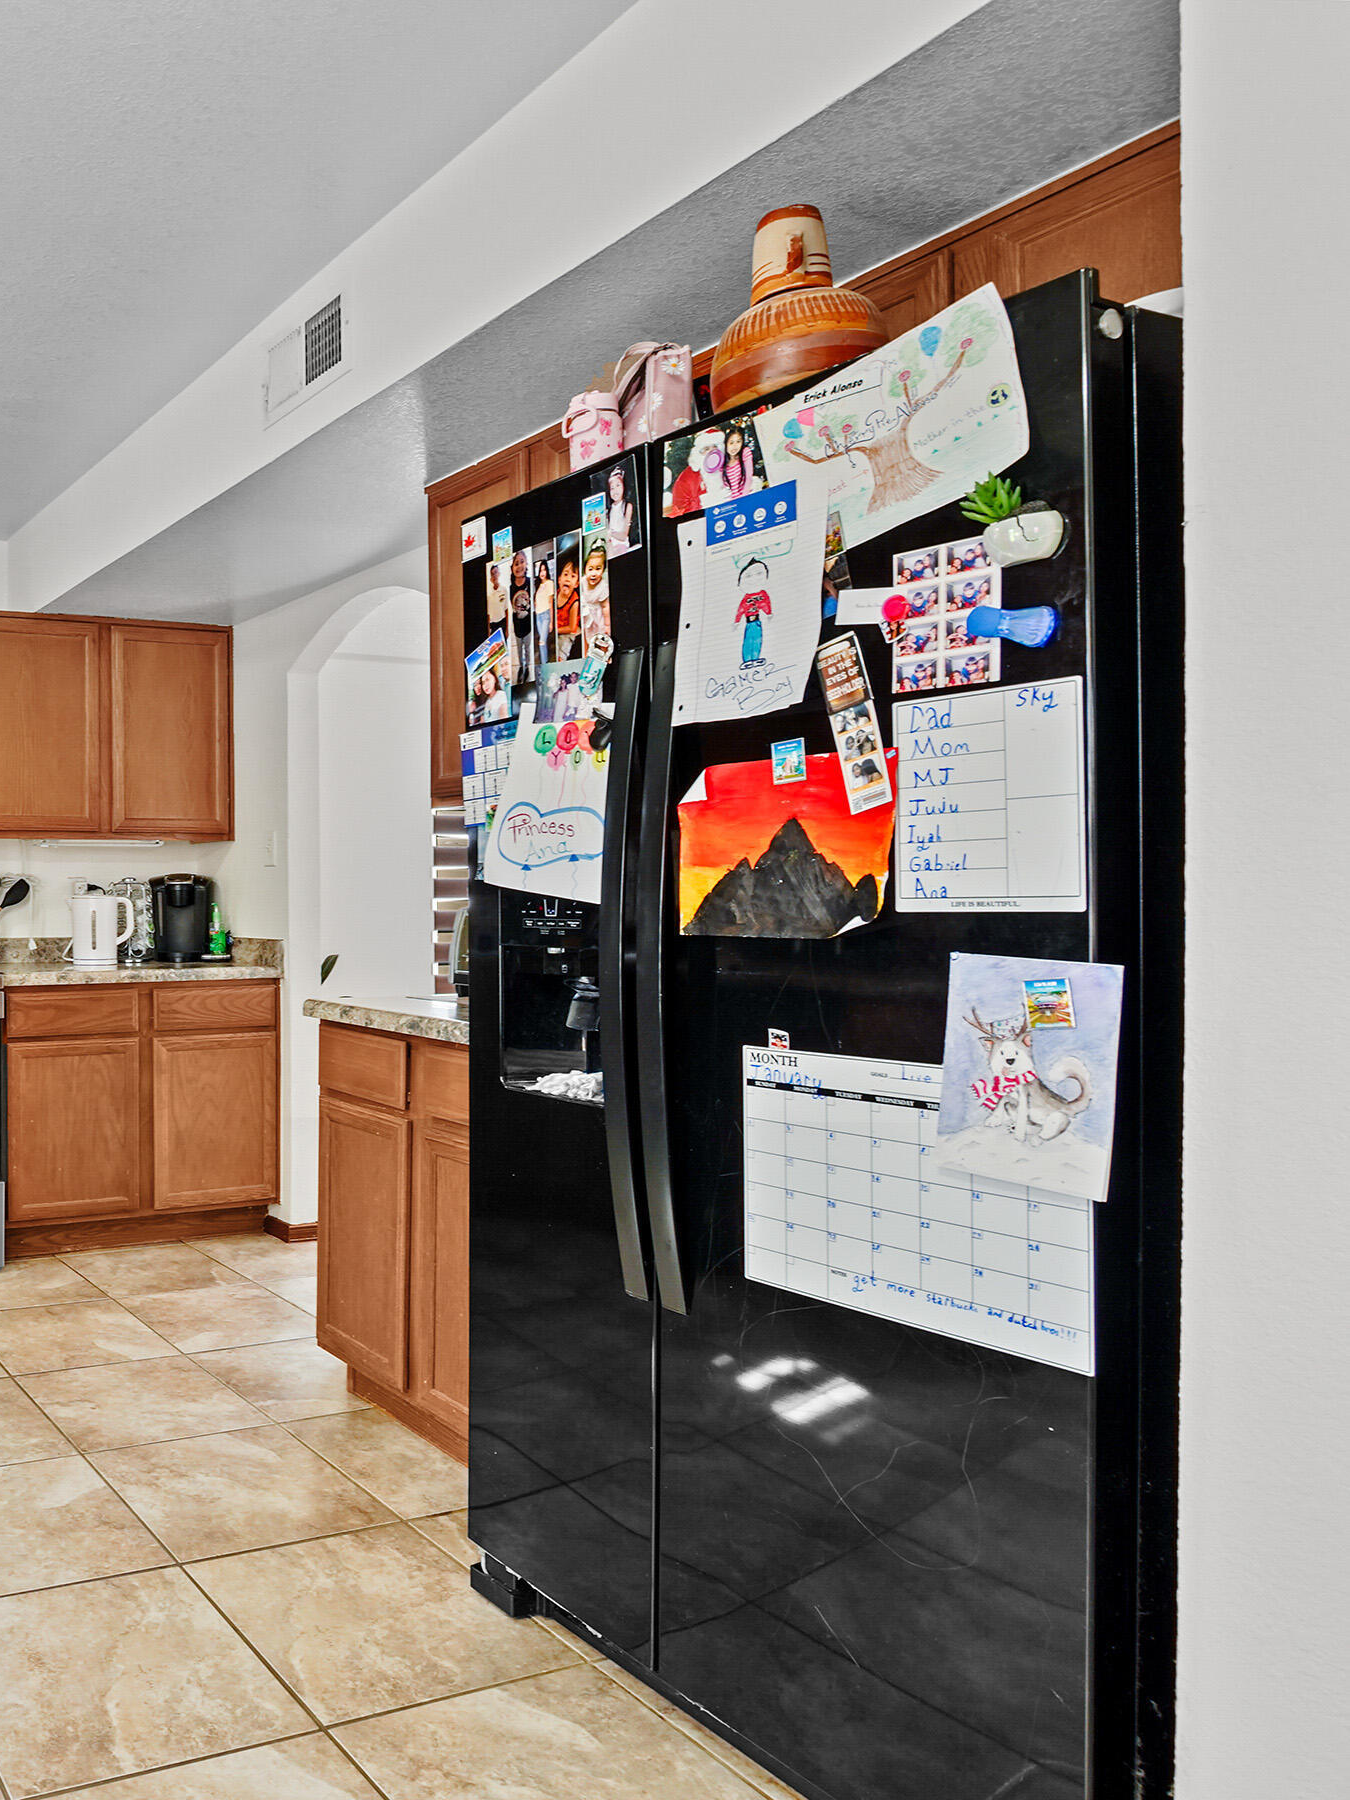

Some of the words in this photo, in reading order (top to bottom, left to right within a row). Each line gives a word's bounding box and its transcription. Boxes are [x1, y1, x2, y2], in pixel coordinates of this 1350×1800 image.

[803, 388, 828, 404] Erick
[830, 378, 864, 397] Alonso
[825, 671, 848, 687] EYES
[847, 666, 860, 677] OF
[909, 699, 954, 734] Dad
[911, 736, 970, 760] Mom
[908, 796, 959, 817] Juju
[507, 812, 576, 843] Princess
[524, 839, 572, 862] Ana
[914, 877, 948, 899] Ana
[750, 1052, 798, 1068] MONTH
[750, 1064, 827, 1100] January
[852, 1271, 877, 1293] get
[886, 1282, 915, 1298] more
[987, 1307, 1003, 1319] and
